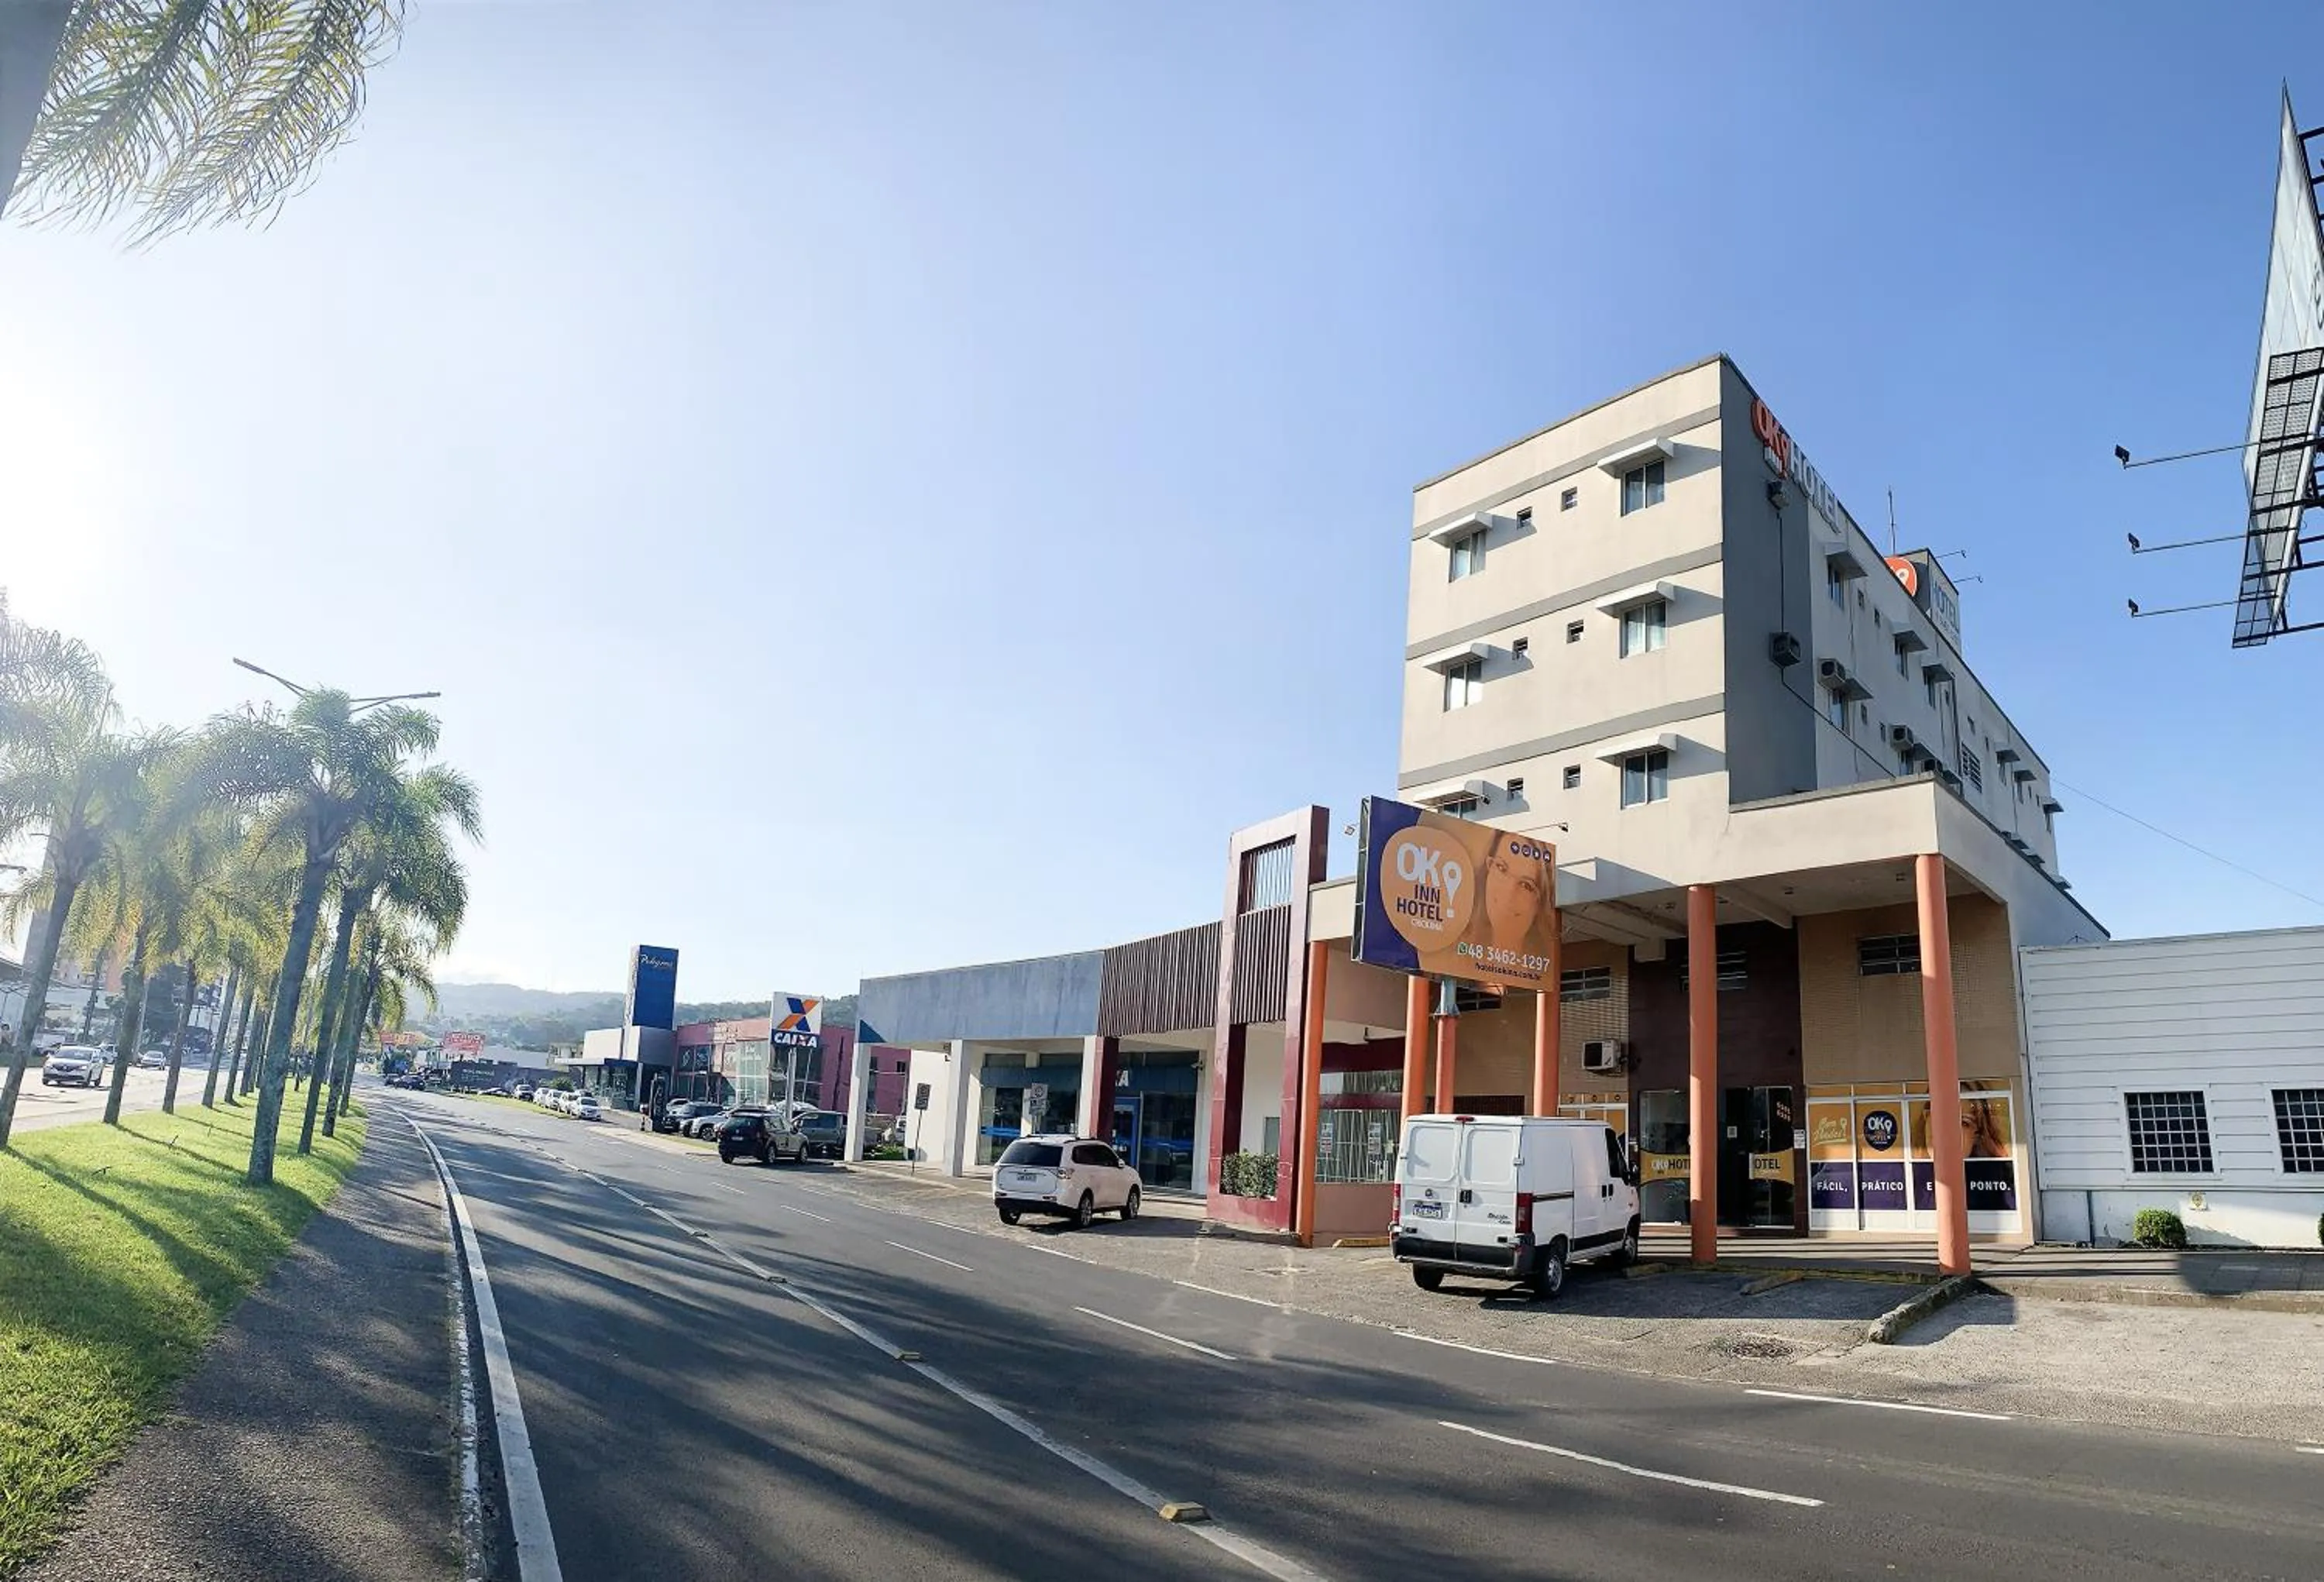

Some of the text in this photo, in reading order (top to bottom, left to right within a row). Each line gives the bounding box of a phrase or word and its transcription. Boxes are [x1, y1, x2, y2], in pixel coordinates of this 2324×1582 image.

[1790, 441, 1841, 533] HOTEL
[1415, 884, 1440, 904] INN
[1397, 896, 1443, 922] HOTEL
[1468, 944, 1550, 972] 48 3462-1297
[774, 1033, 817, 1048] CAIXA
[1669, 1159, 1690, 1169] HOT
[1755, 1159, 1781, 1169] OTEL
[1817, 1178, 1933, 1192] FÁCIL, PRÁTICO E
[1970, 1181, 2011, 1191] PONTO.
